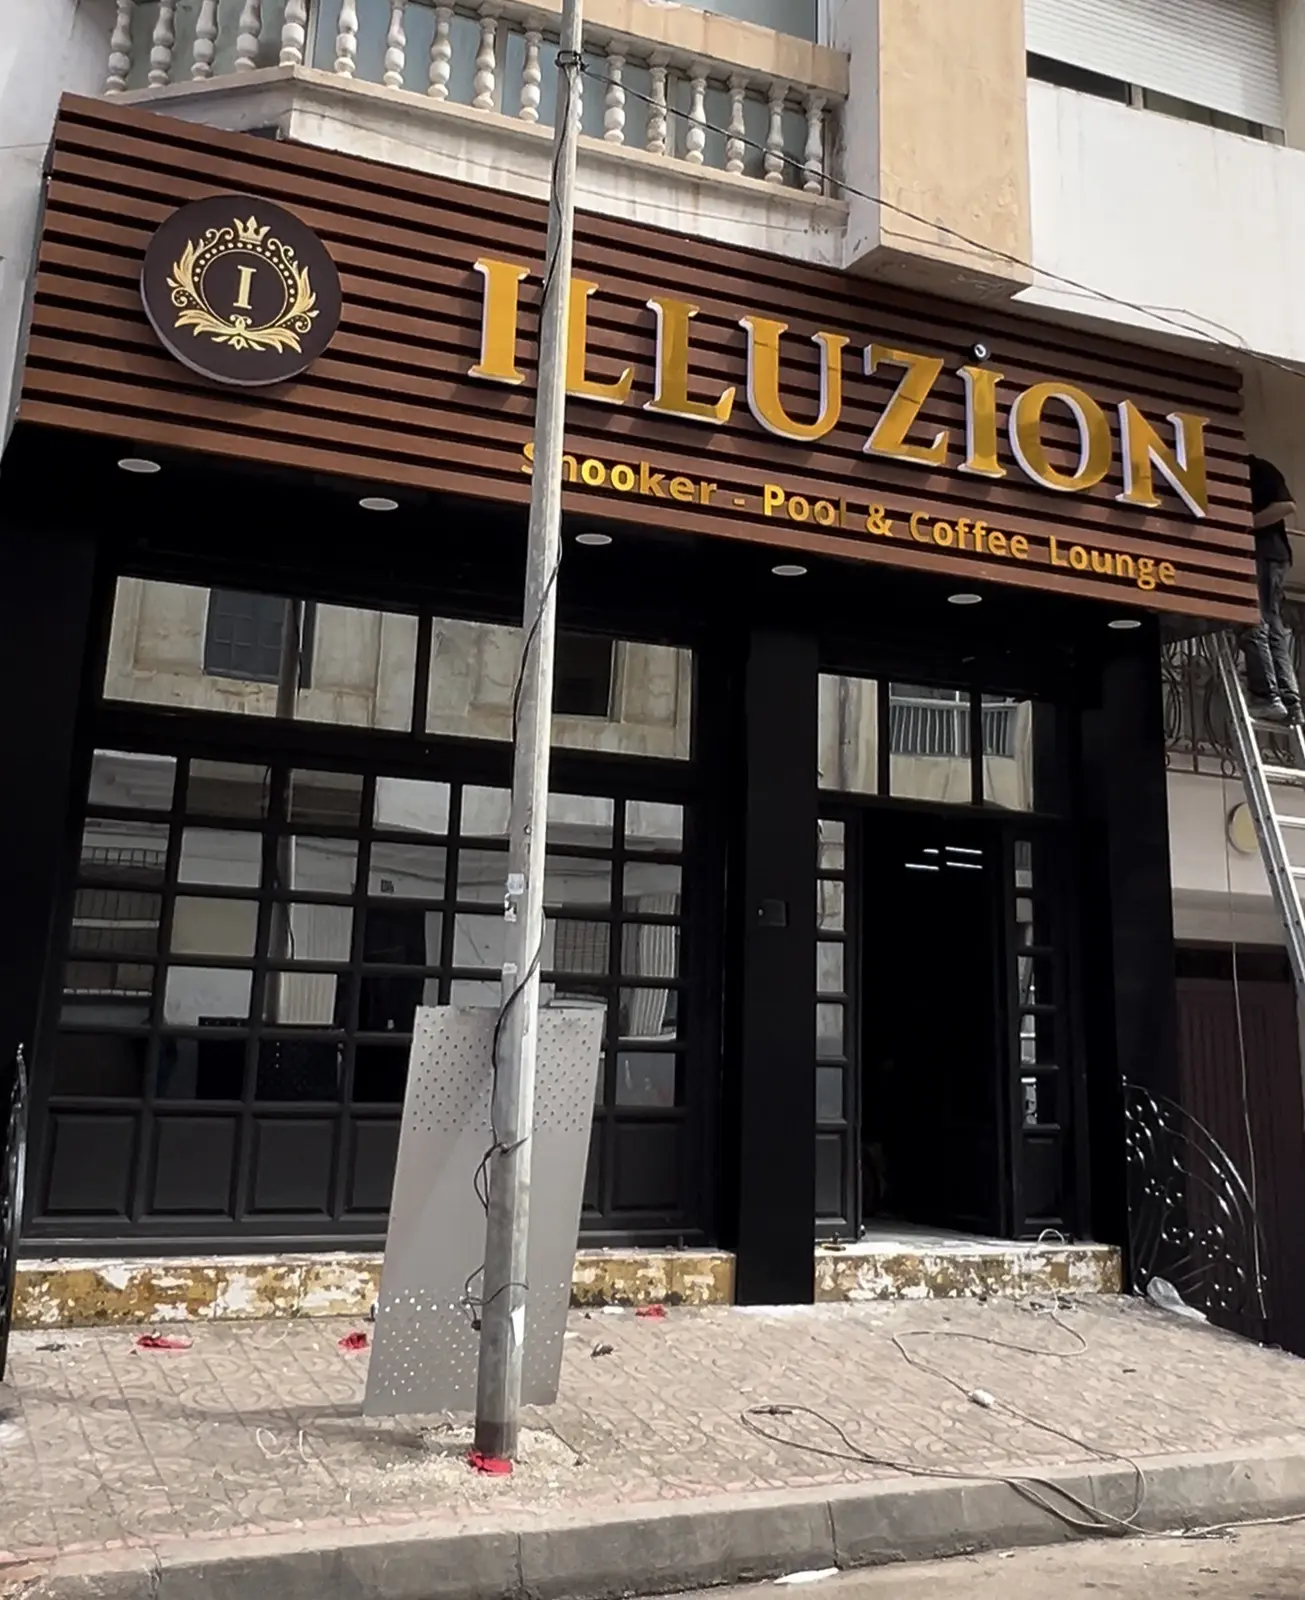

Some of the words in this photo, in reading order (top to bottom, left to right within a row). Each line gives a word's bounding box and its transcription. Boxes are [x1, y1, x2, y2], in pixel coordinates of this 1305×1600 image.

[232, 265, 257, 309] I
[468, 257, 1210, 517] ILLUZION
[762, 483, 847, 527] Pool
[865, 503, 894, 537] &
[909, 510, 1029, 560] Coffee
[1048, 534, 1177, 590] Lounge
